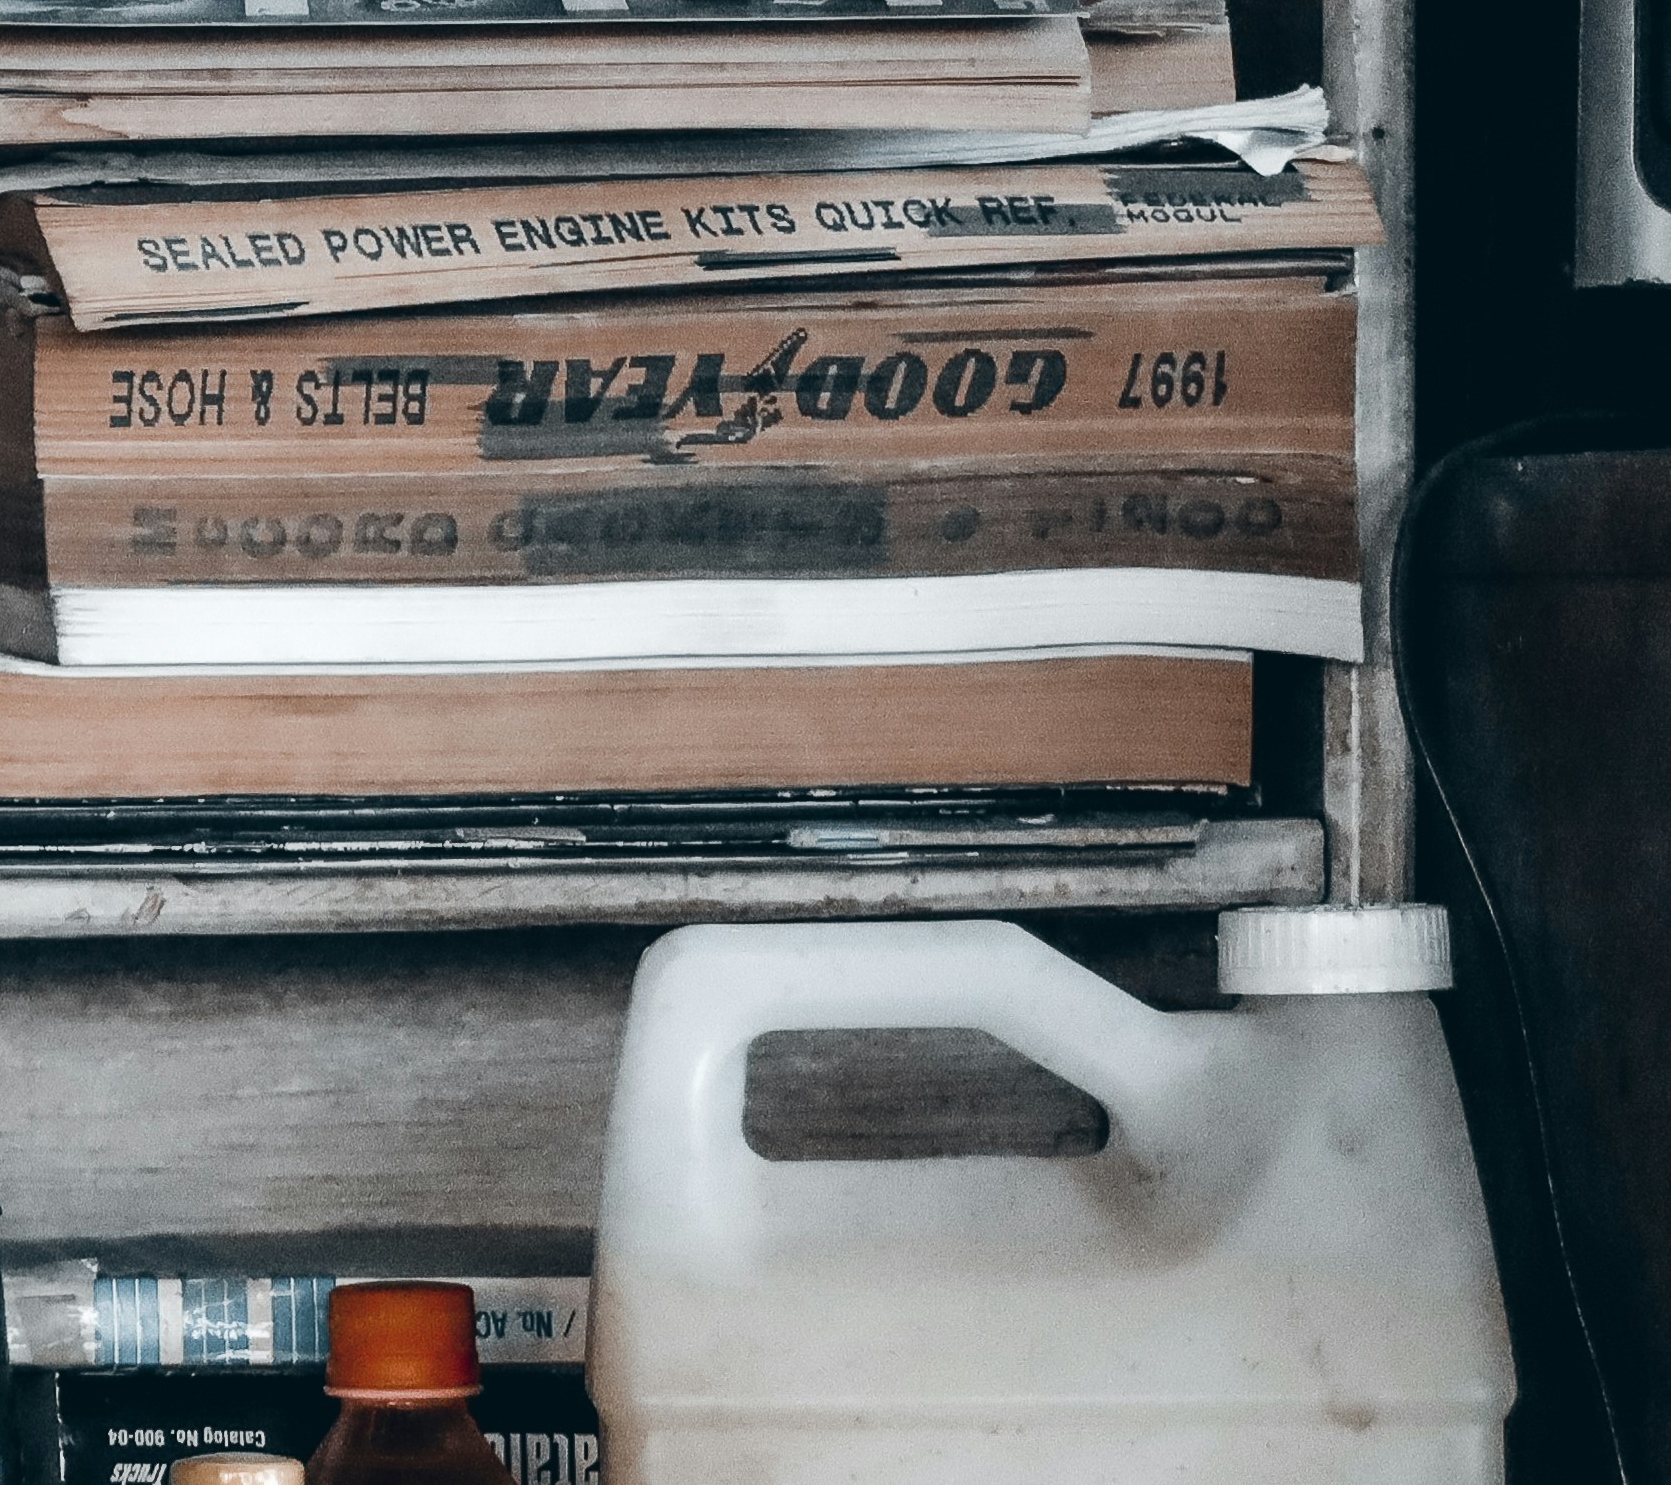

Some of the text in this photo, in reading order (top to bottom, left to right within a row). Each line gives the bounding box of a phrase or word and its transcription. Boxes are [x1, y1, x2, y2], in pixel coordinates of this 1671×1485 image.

[136, 230, 307, 274] SEALED
[320, 221, 482, 262] POWER
[490, 208, 673, 253] ENGINE
[680, 201, 798, 242] KITS
[813, 195, 961, 237] QUICK
[108, 337, 1230, 456] 1997 GOODYEAR BELTS & HOSE
[107, 1427, 267, 1448] Catalog No. 900-04
